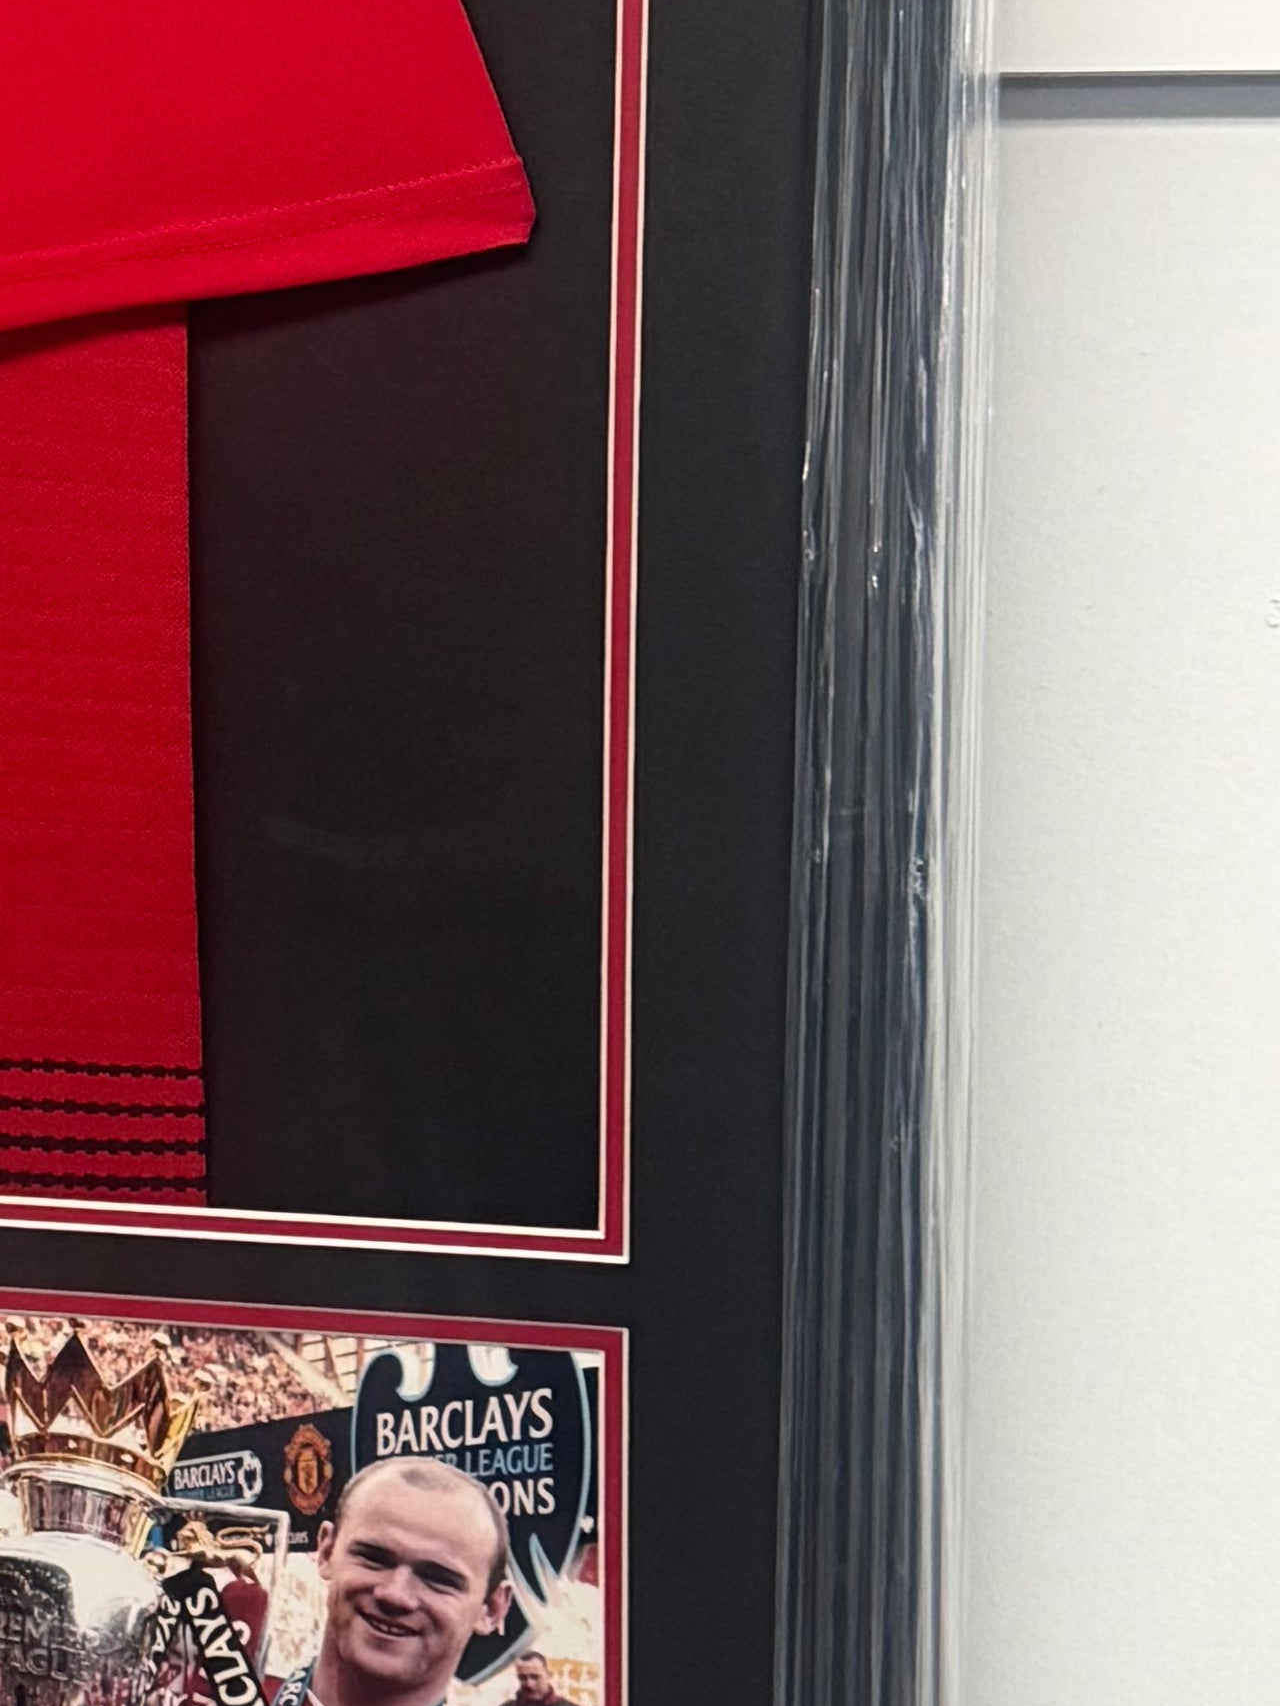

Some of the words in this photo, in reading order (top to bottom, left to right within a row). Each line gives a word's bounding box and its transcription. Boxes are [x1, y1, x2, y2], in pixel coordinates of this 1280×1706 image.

[376, 1387, 554, 1457] BARCLAYS
[173, 1459, 237, 1491] BARCLAYS
[465, 1442, 554, 1477] LEAGUE
